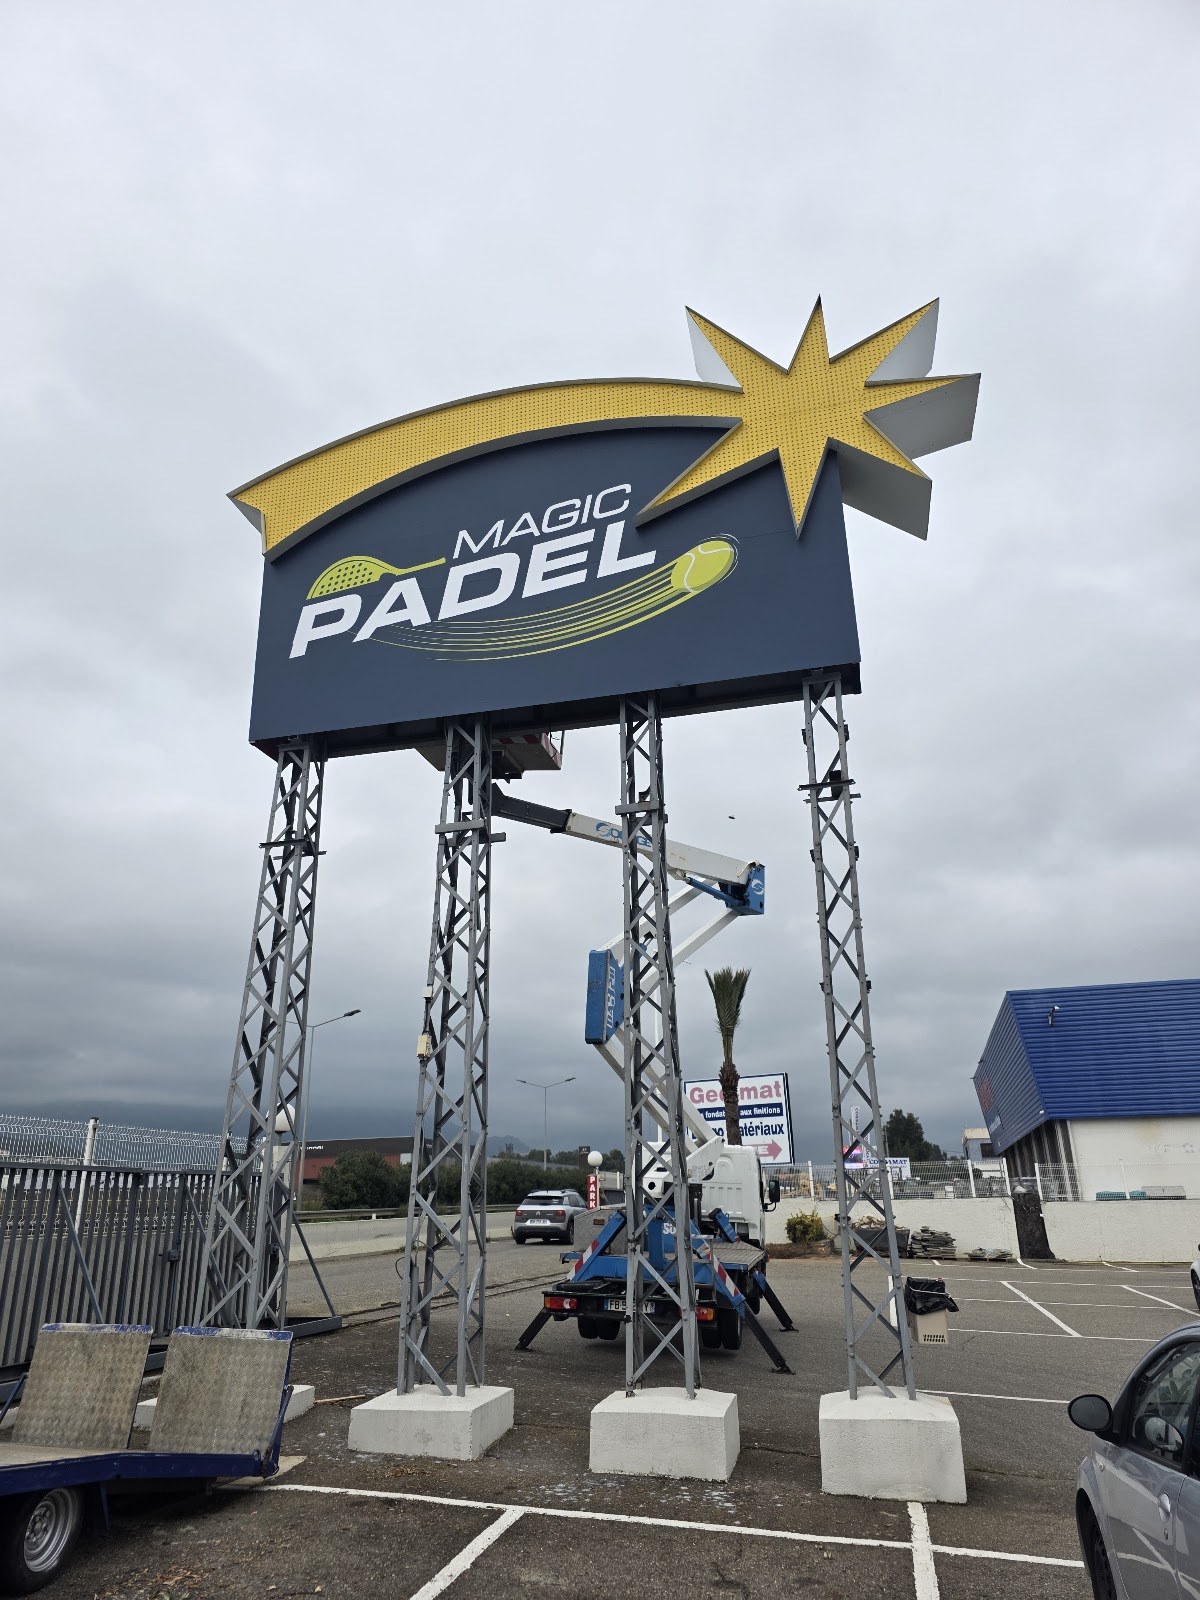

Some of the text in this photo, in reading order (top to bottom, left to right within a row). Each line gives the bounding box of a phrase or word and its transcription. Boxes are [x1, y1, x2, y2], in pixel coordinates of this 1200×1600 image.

[453, 483, 632, 559] MAGIC
[289, 520, 657, 659] PADEL
[689, 1080, 782, 1104] Gemat
[739, 1121, 785, 1137] atériaux
